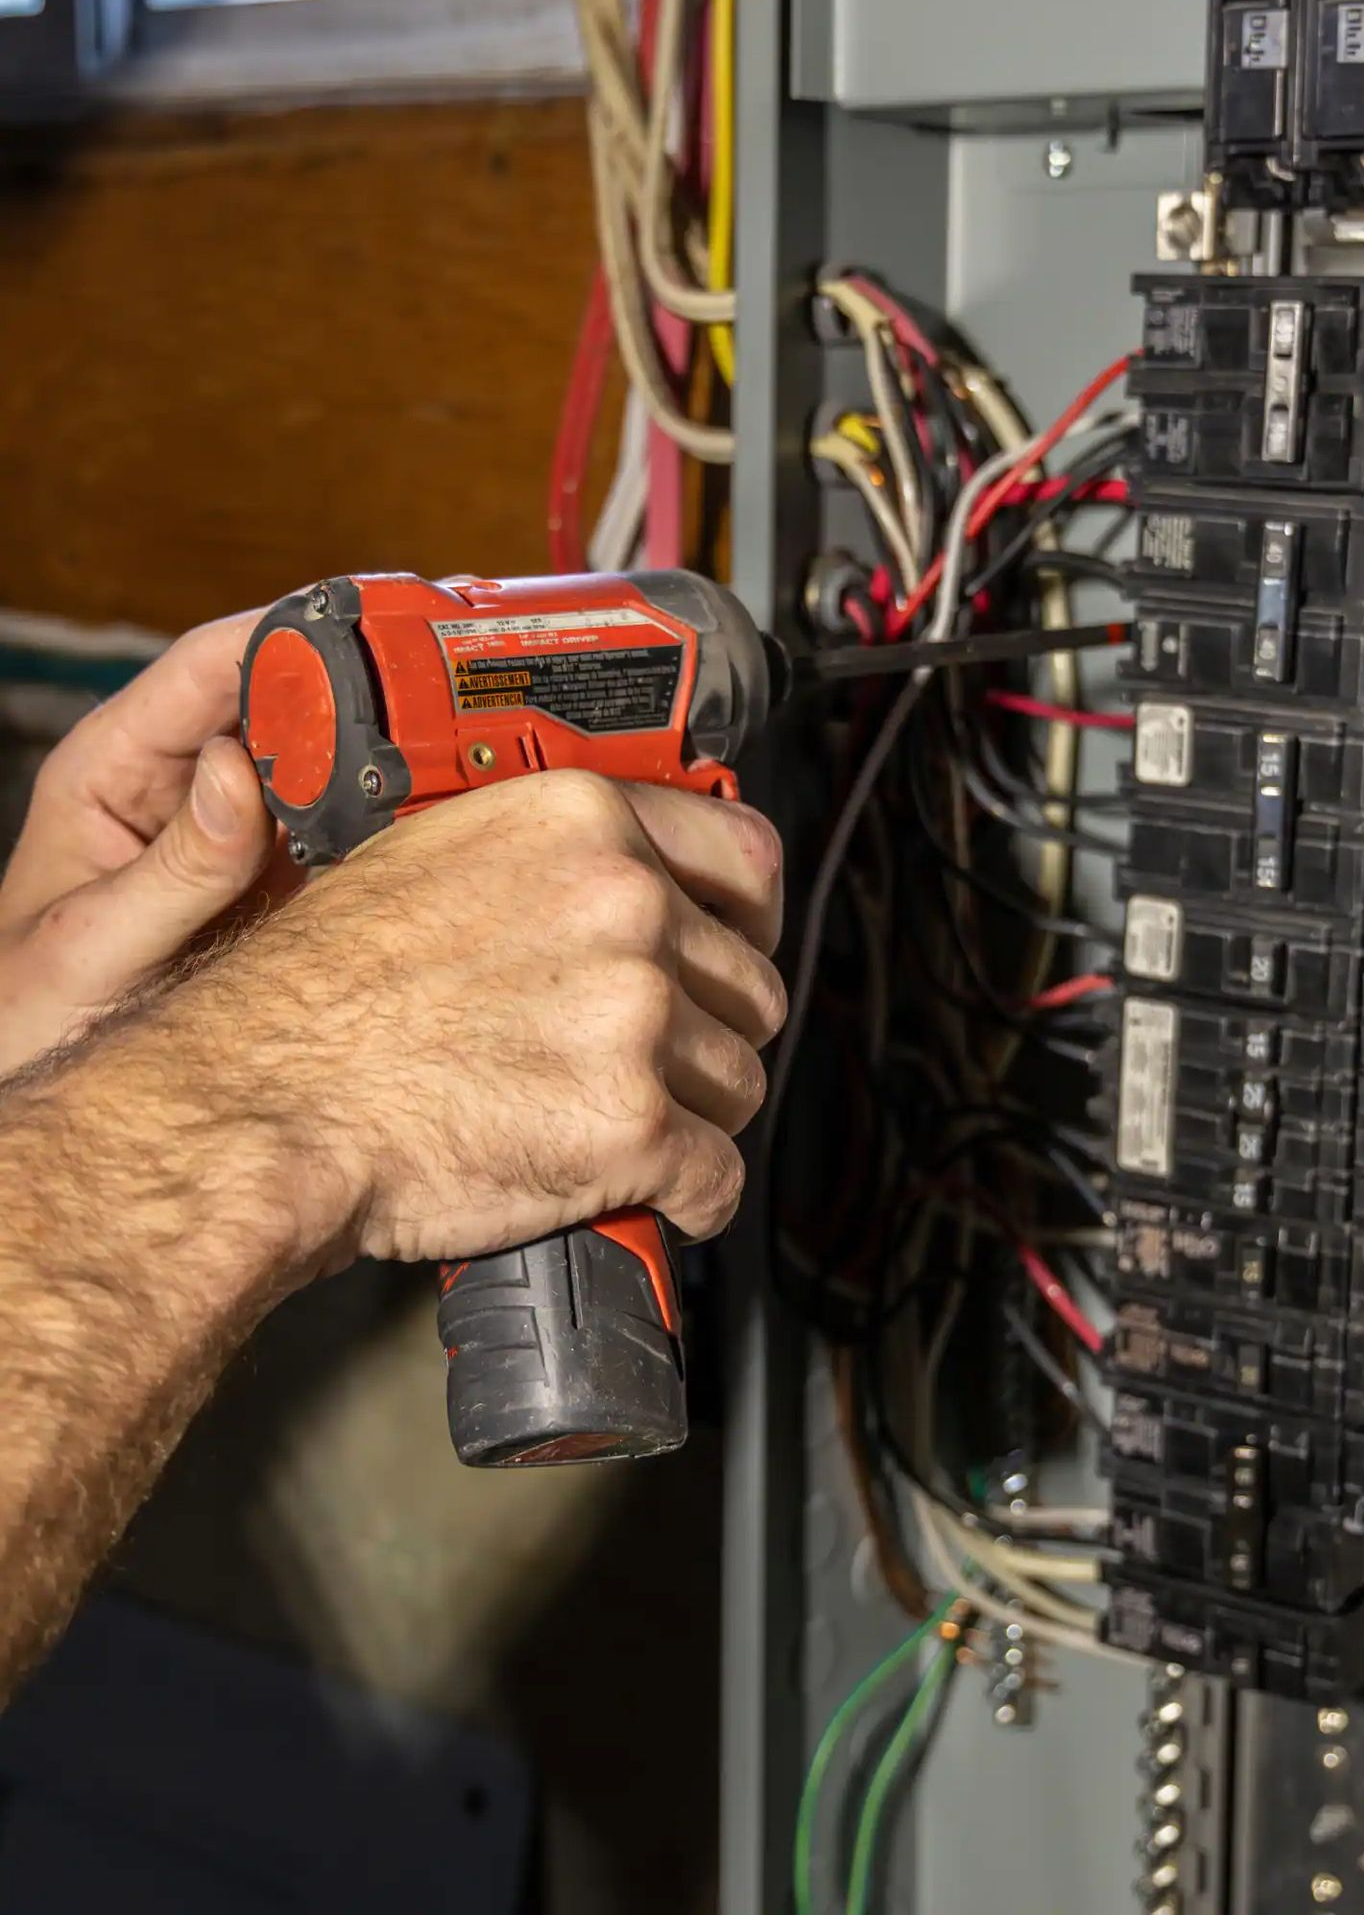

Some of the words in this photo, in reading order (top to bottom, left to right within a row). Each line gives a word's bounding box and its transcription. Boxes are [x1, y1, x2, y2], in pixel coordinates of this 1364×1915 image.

[470, 672, 529, 689] AVERTISSEMENT
[472, 693, 522, 709] ADVERTENCIA
[1260, 752, 1280, 777] 15
[1256, 856, 1277, 880] 15
[1250, 955, 1270, 981] 20
[1246, 1032, 1268, 1059] 15
[1232, 1183, 1256, 1208] 15
